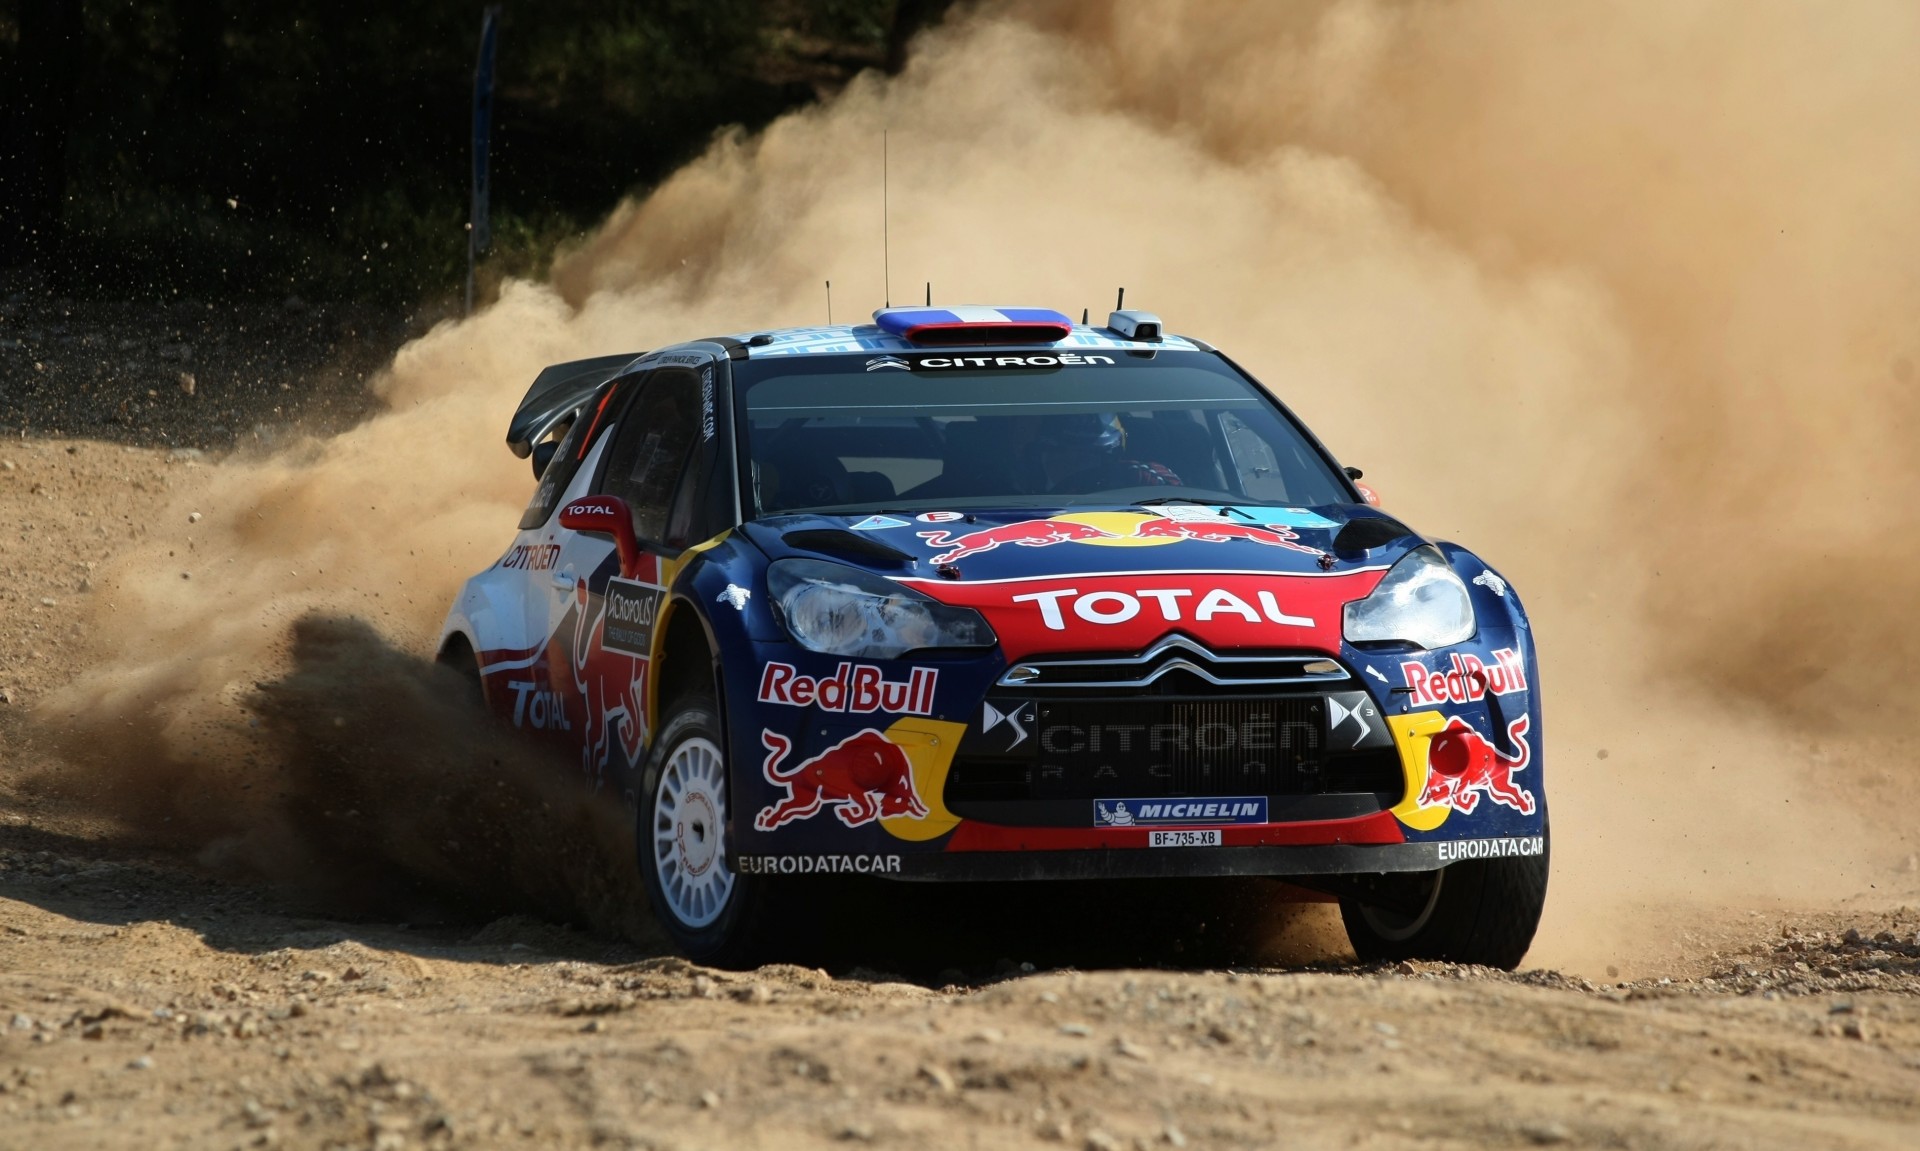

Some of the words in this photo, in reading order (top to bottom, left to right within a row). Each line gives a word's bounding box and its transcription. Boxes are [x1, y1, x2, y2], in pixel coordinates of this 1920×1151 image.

[920, 353, 1115, 367] CITROËN
[568, 505, 615, 516] TOTAL
[926, 512, 953, 522] E
[503, 535, 561, 571] CITROËN
[608, 589, 653, 625] ACROPOLIS
[1012, 588, 1316, 630] TOTAL
[508, 681, 571, 731] TOTAL
[1041, 713, 1319, 753] CITROËN
[1138, 803, 1260, 818] MICHELIN
[1154, 832, 1216, 846] BF-735-XB
[1438, 837, 1544, 860] EURODATACAR
[739, 854, 901, 874] EURODATACAR
